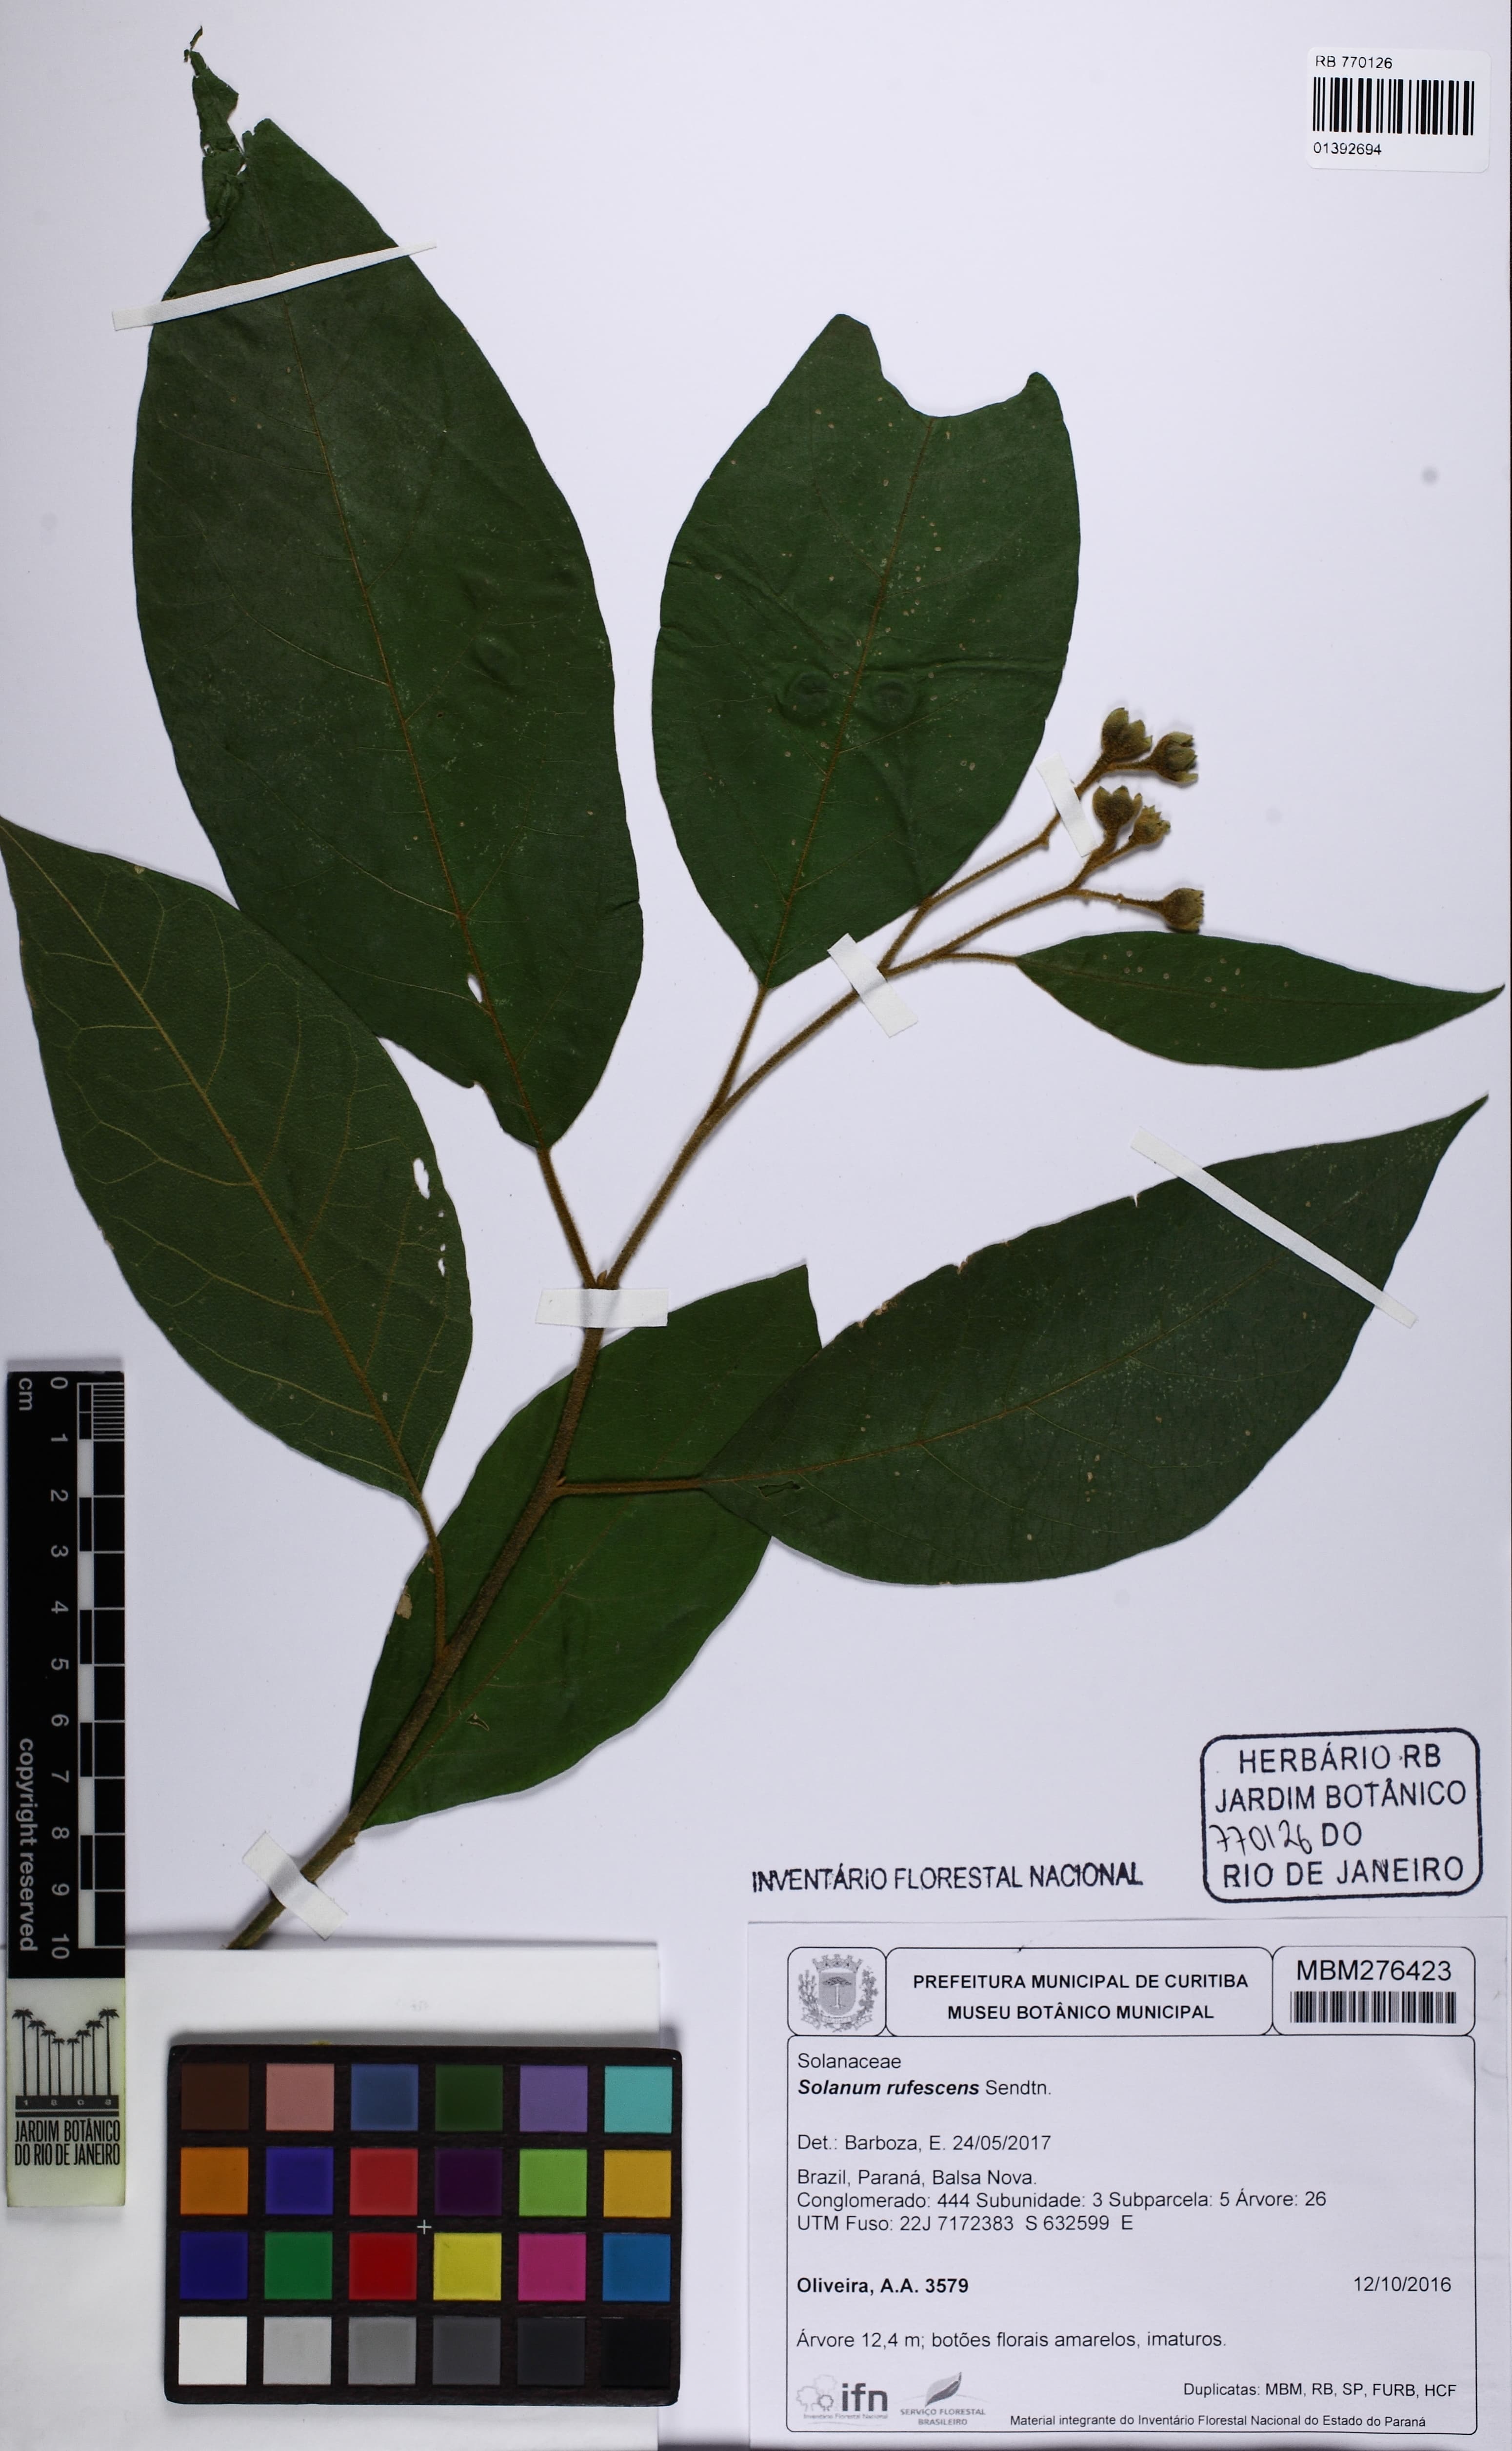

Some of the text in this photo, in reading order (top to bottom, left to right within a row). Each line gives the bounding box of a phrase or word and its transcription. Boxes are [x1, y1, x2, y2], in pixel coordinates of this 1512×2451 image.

[1316, 55, 1393, 69] RB 770126
[1313, 141, 1382, 156] 01392694
[50, 1376, 68, 1390] 0
[19, 1377, 33, 1411] cm
[50, 1433, 68, 1442] 1
[50, 1489, 69, 1502] 2
[50, 1545, 69, 1558] 3
[51, 1600, 69, 1614] 4
[51, 1658, 69, 1671] 5
[51, 1714, 69, 1727] 6
[1239, 1741, 1441, 1774] HERBÁRIO RB
[51, 1770, 70, 1783] 7
[1215, 1777, 1466, 1813] JARDIM BOTÂNICO
[51, 1826, 70, 1839] 8
[1209, 1819, 1313, 1856] 770126
[1322, 1821, 1362, 1847] DO
[15, 1738, 38, 1951] copyright reserved
[752, 1861, 1144, 1893] INVENTÁRIO FLORESTAL NACIONAL
[1223, 1856, 1464, 1888] RIO DE JANEIRO
[51, 1883, 70, 1896] 9
[51, 1933, 70, 1959] 10
[1297, 1959, 1452, 1981] MBM276423
[914, 1974, 1249, 1989] PREFEITURA MUNICIPAL DE CURITIBA
[948, 2002, 1214, 2020] MUSEU BOTÂNICO MUNICIPAL
[798, 2052, 901, 2069] Solanaceae
[798, 2079, 1051, 2095] Solanum rufescens Sendtn.
[15, 2118, 120, 2142] JARDIM BOTÂNICO
[798, 2134, 1051, 2152] Det.: Barboza, E. 24/05/2017
[15, 2143, 120, 2166] DO RIO DE JANEIRO
[798, 2169, 1036, 2187] Brazil, Paraná, Balsa Nova.
[797, 2188, 1326, 2212] Conglomerado: 444 Subunidade: 3 Subparcela: 5 Árvore: 26
[798, 2214, 1133, 2231] UTM Fuso: 22J 7172383 S 632599 E
[797, 2277, 969, 2296] Oliveira, A.A. 3579
[1354, 2276, 1452, 2292] 12/10/2016
[796, 2328, 1226, 2350] Árvore 12,4 m; botões florais amarelos, imaturos.
[842, 2383, 888, 2412] ifn
[1184, 2382, 1457, 2399] Duplicatas: MBM, RB, SP, FURB, HCF
[900, 2408, 937, 2417] SERVIÇO
[1010, 2414, 1426, 2428] Material integrante do Inventário Florestal Nacional do Estado do Paraná
